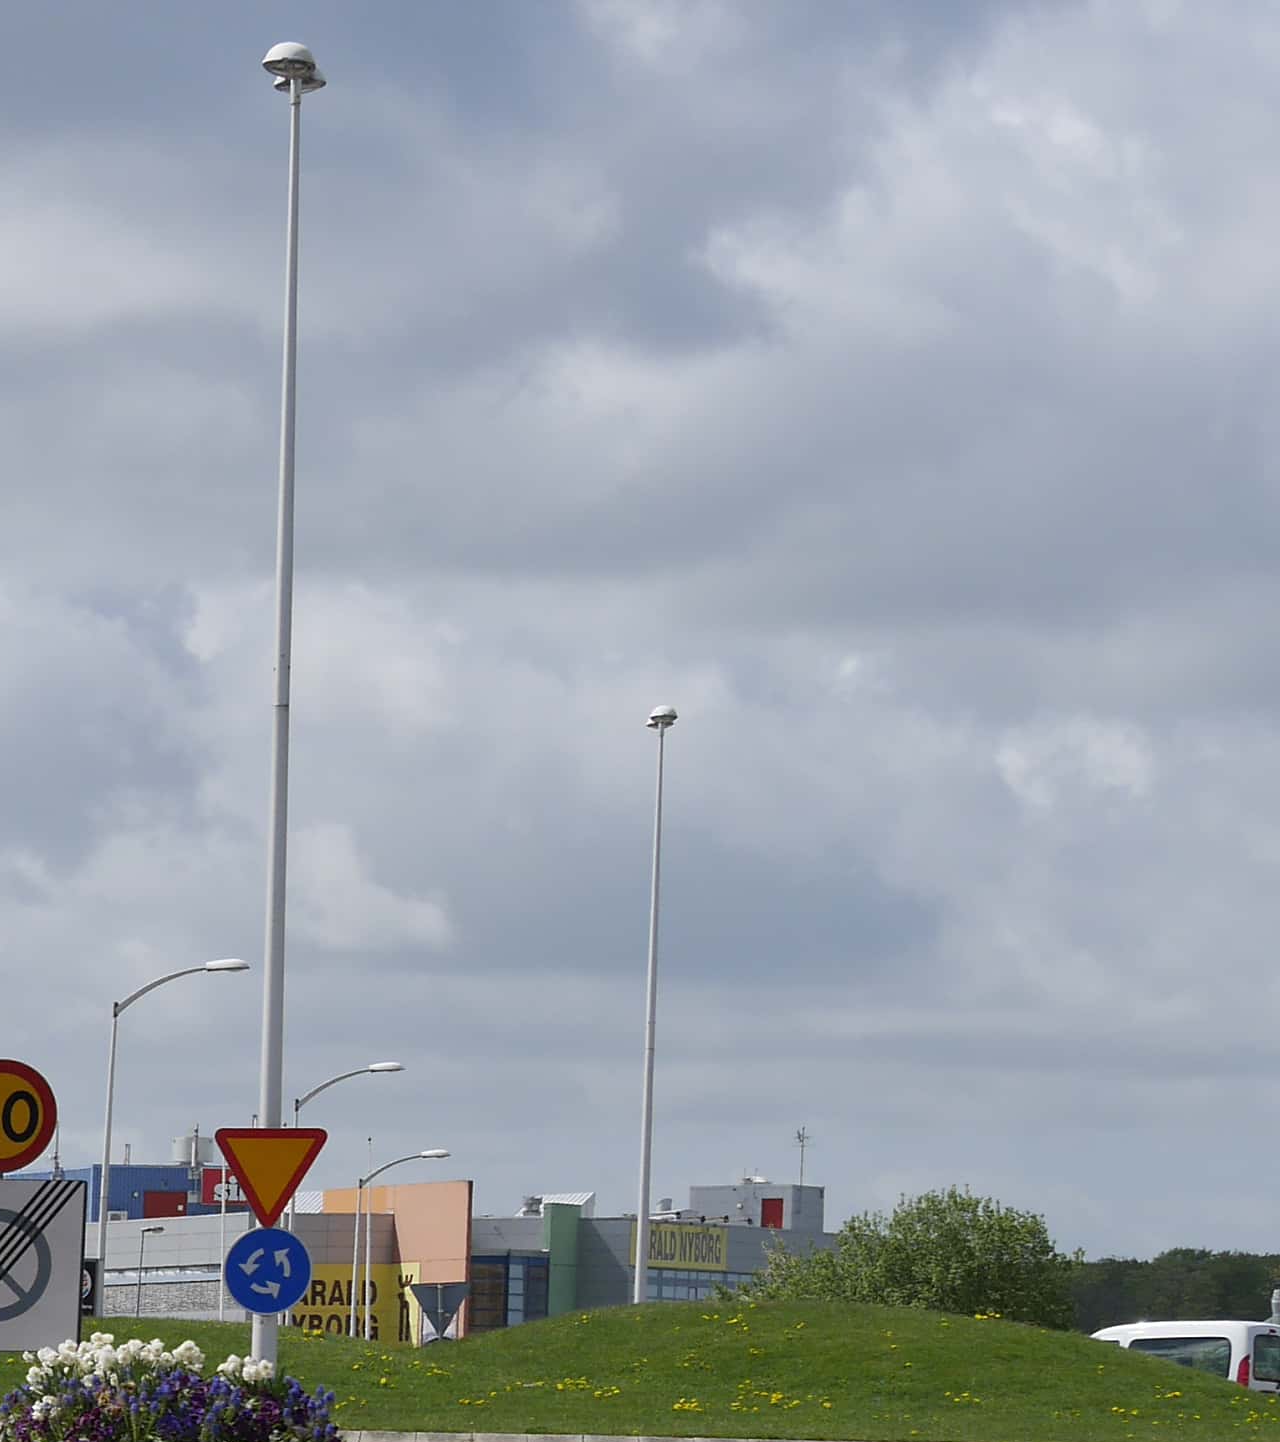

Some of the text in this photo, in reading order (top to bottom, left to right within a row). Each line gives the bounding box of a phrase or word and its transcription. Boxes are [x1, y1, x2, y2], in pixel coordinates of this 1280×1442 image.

[650, 1230, 721, 1264] RALD NYBORG
[292, 1314, 378, 1341] YBORG
